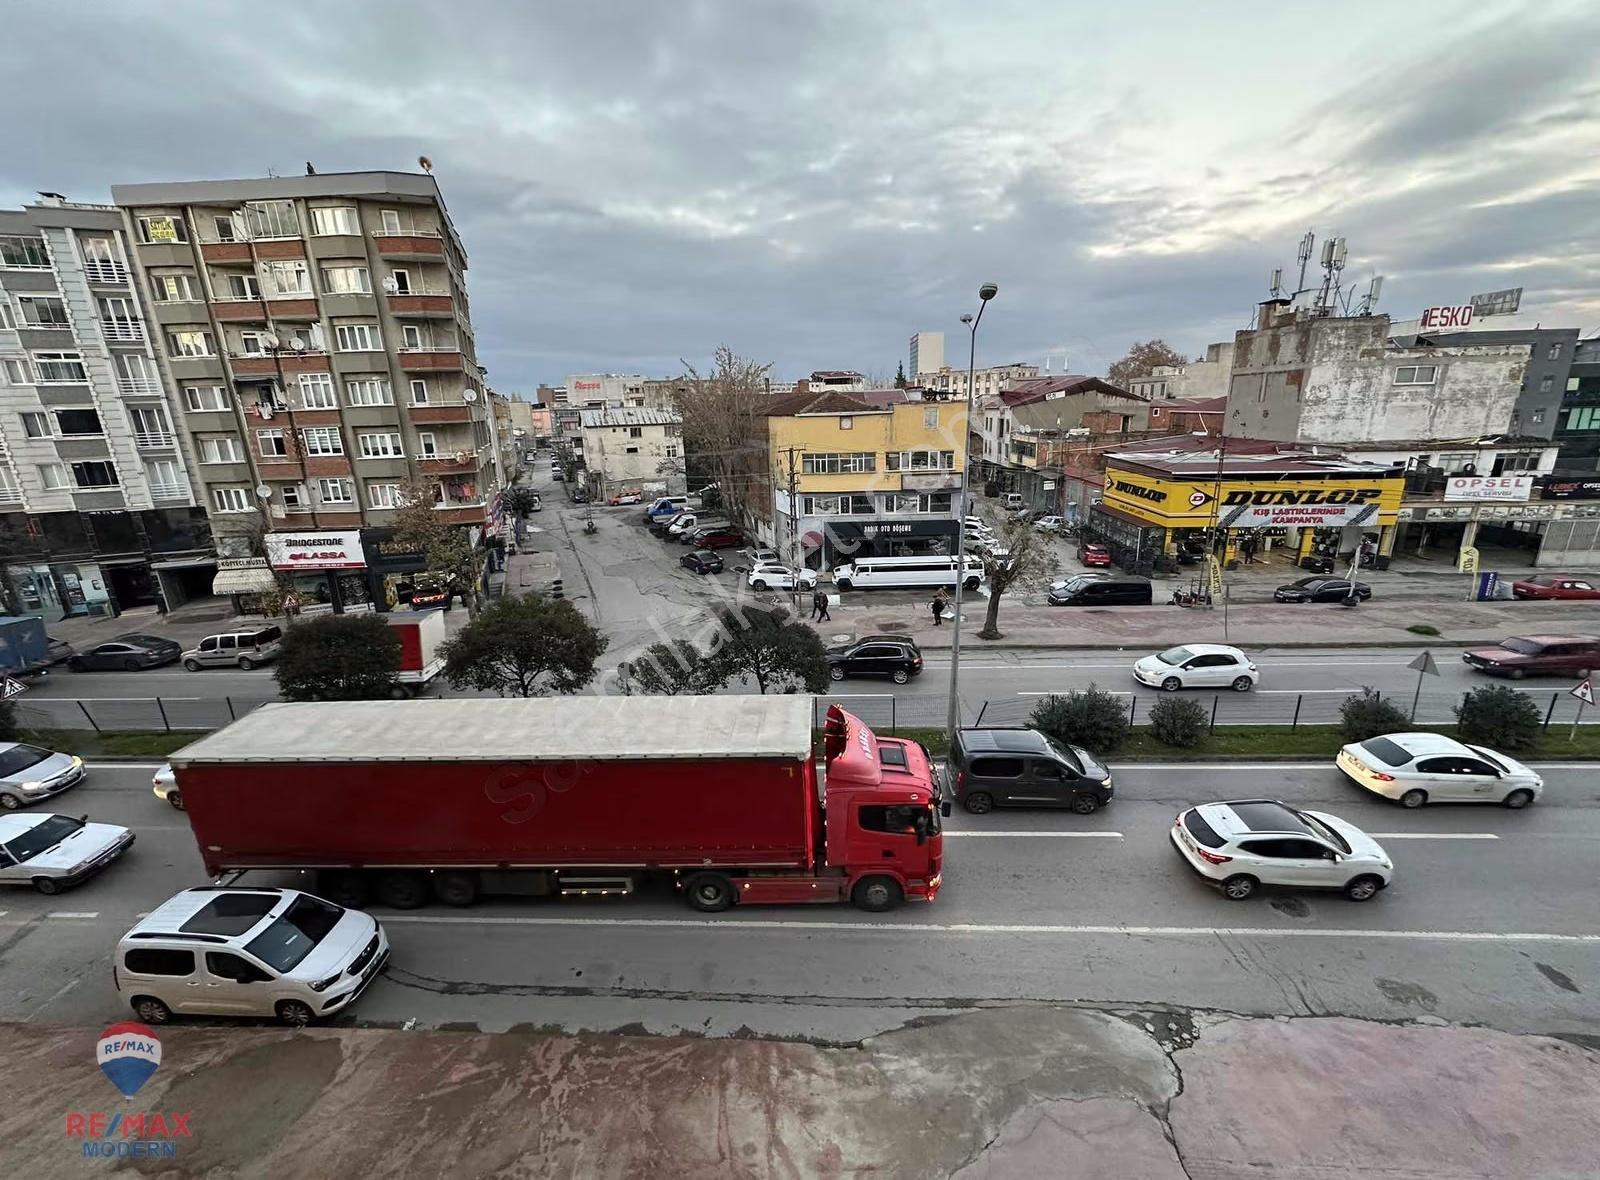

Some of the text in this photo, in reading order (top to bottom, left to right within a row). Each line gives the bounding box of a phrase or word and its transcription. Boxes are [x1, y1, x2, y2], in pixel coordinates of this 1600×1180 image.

[1454, 479, 1524, 488] OPSEL
[1115, 480, 1167, 502] DUNLOP
[1221, 490, 1382, 505] DUNLOP
[285, 538, 344, 547] BRIDGESTONE
[303, 551, 347, 560] LASSA
